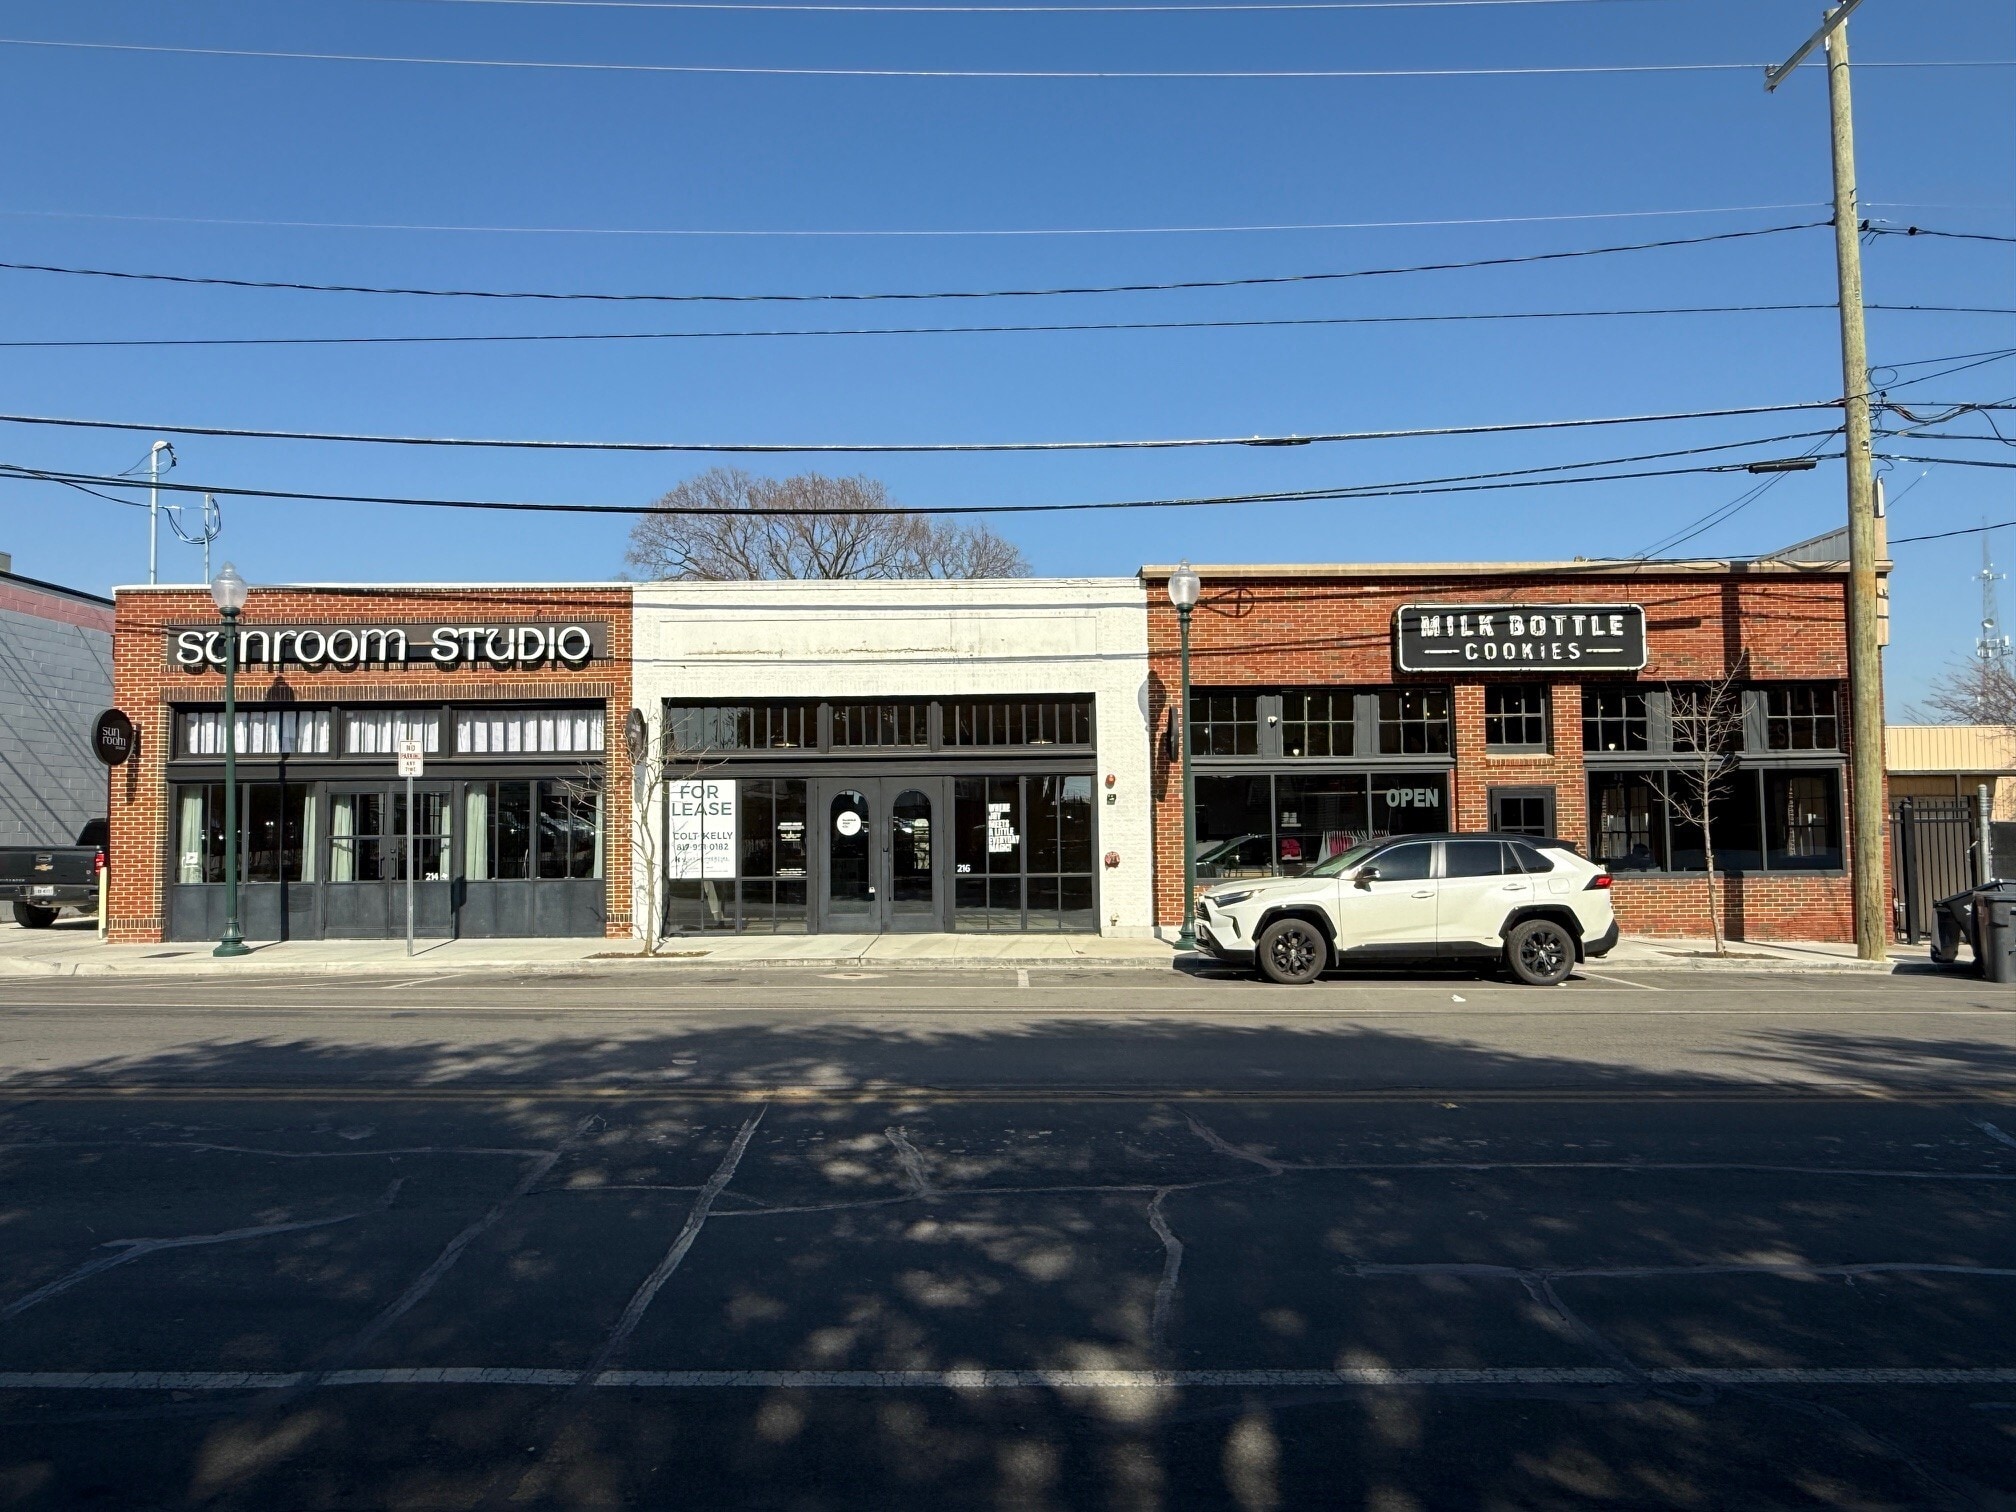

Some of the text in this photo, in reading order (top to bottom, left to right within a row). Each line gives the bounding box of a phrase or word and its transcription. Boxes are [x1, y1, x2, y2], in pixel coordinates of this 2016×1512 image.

[1420, 614, 1625, 637] MILK BOTTLE
[1465, 642, 1581, 660] COOKIES
[102, 726, 120, 737] sun
[102, 735, 126, 746] room
[680, 785, 719, 799] FOR
[1386, 788, 1439, 807] OPEN
[671, 801, 733, 817] LEASE
[673, 831, 733, 840] COLT KELLY
[956, 864, 971, 873] 216
[425, 872, 439, 881] 214
